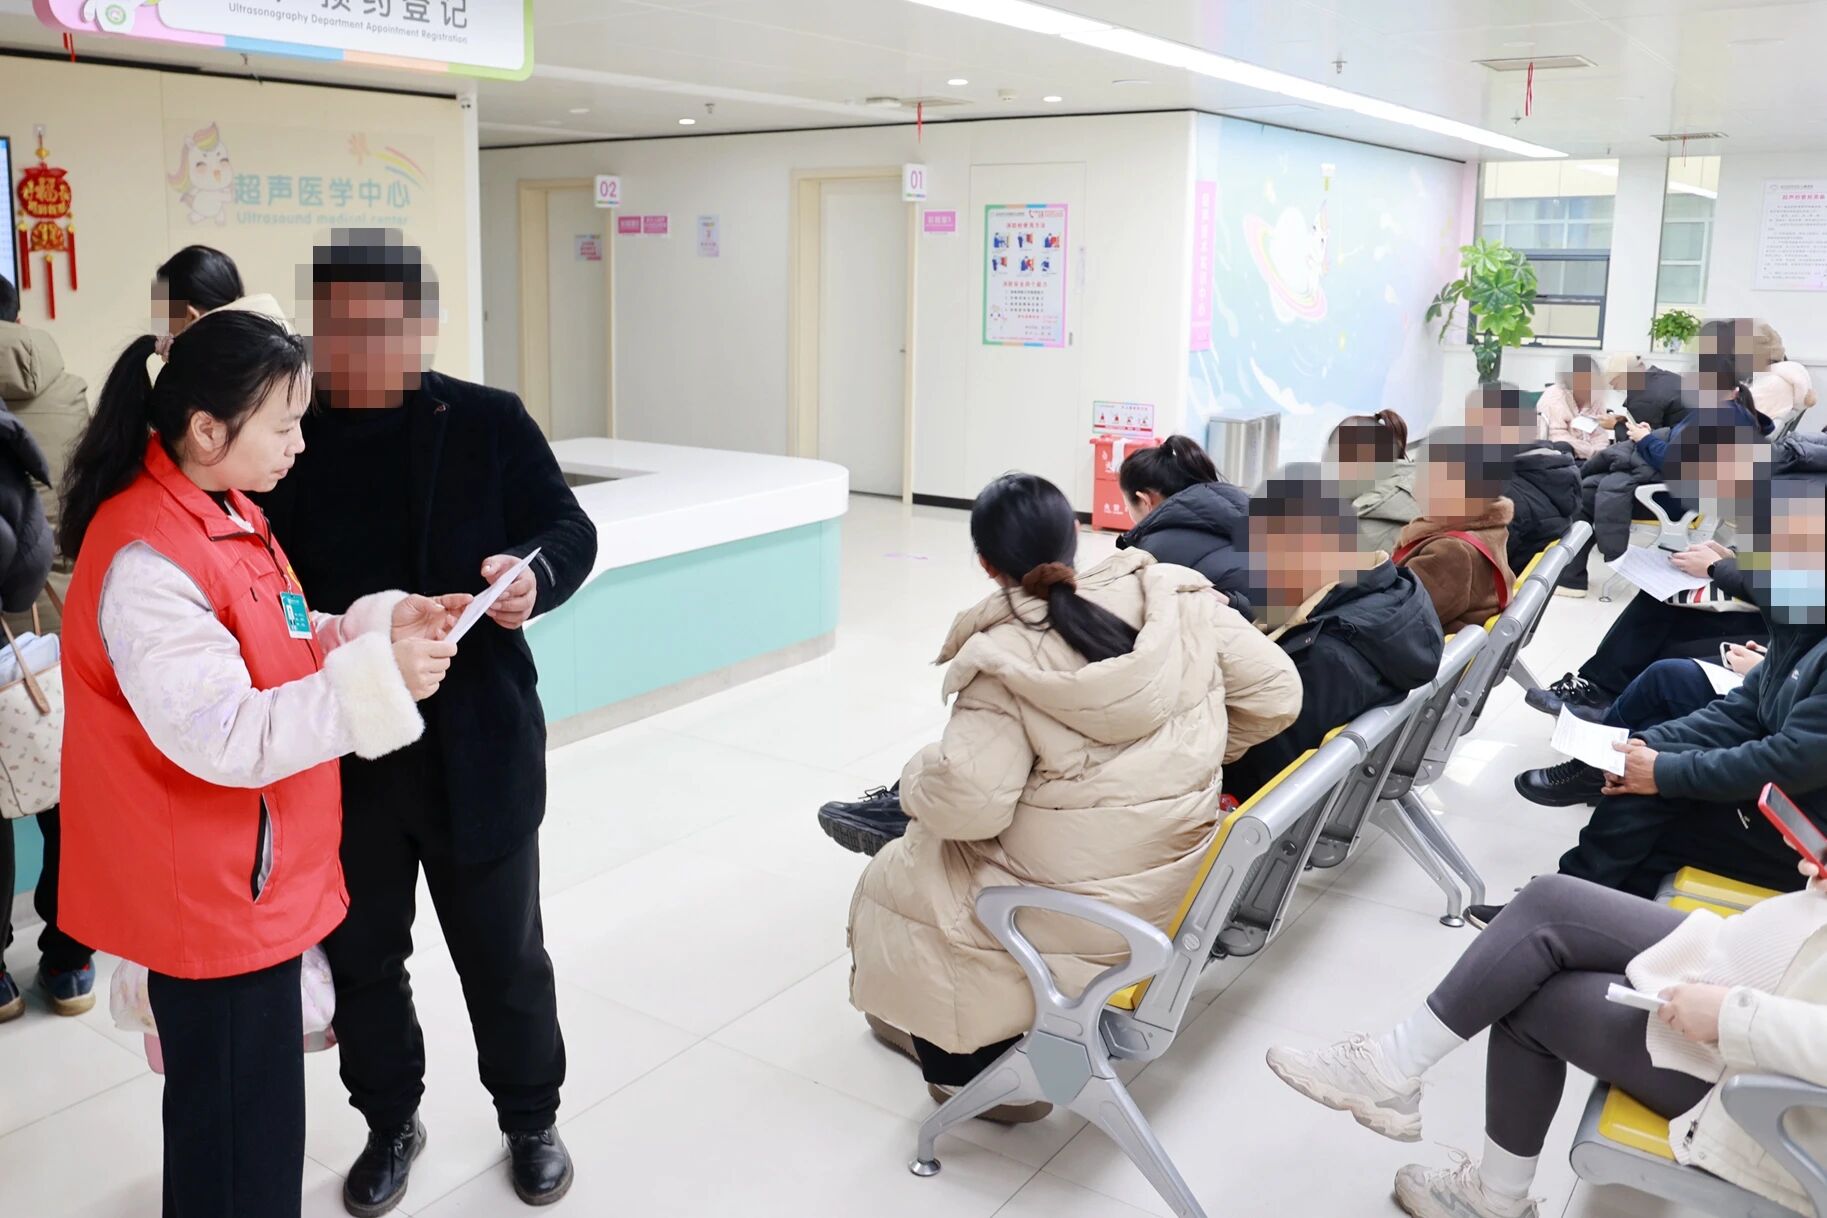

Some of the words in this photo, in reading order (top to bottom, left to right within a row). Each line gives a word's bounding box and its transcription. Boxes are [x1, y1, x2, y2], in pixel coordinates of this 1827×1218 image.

[228, 3, 309, 25] Ultrasonography
[311, 14, 363, 31] Department
[366, 22, 419, 38] Appointment
[421, 29, 468, 44] Registration
[600, 181, 617, 198] 02
[911, 170, 922, 190] 01
[234, 174, 411, 209] 超声医学中心
[236, 211, 312, 225] Ultrasound
